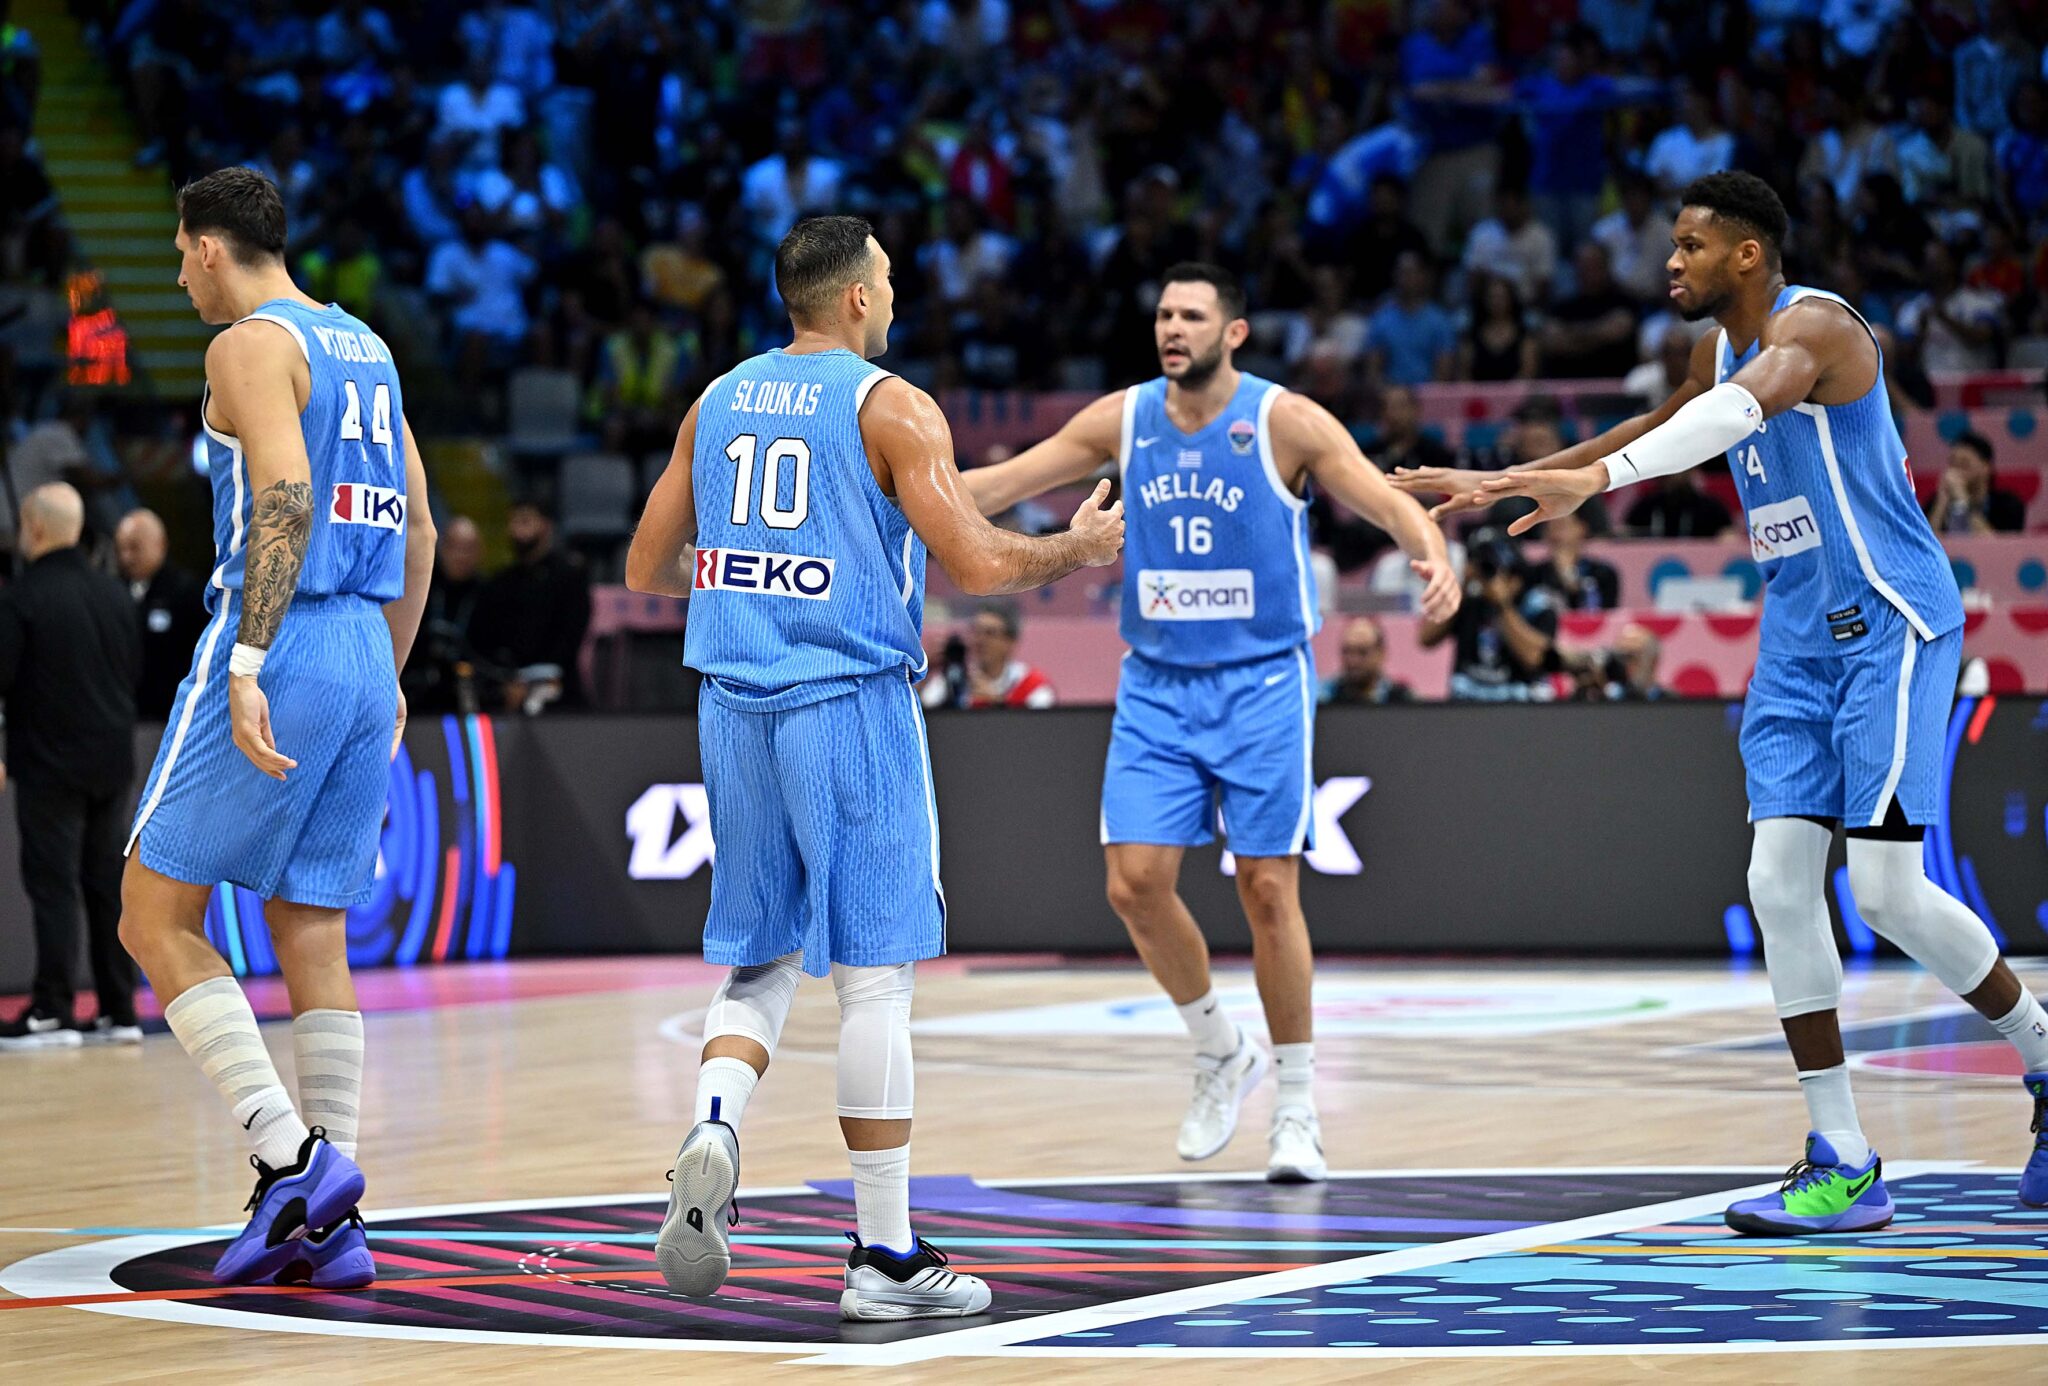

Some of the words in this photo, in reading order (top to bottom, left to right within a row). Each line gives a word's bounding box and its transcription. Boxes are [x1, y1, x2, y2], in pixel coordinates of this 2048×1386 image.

[730, 379, 823, 416] SLOUKAS
[340, 379, 393, 467] 44
[724, 433, 812, 530] 10
[1139, 471, 1245, 513] HELLAS
[1168, 515, 1214, 555] 16
[722, 553, 831, 596] EKO
